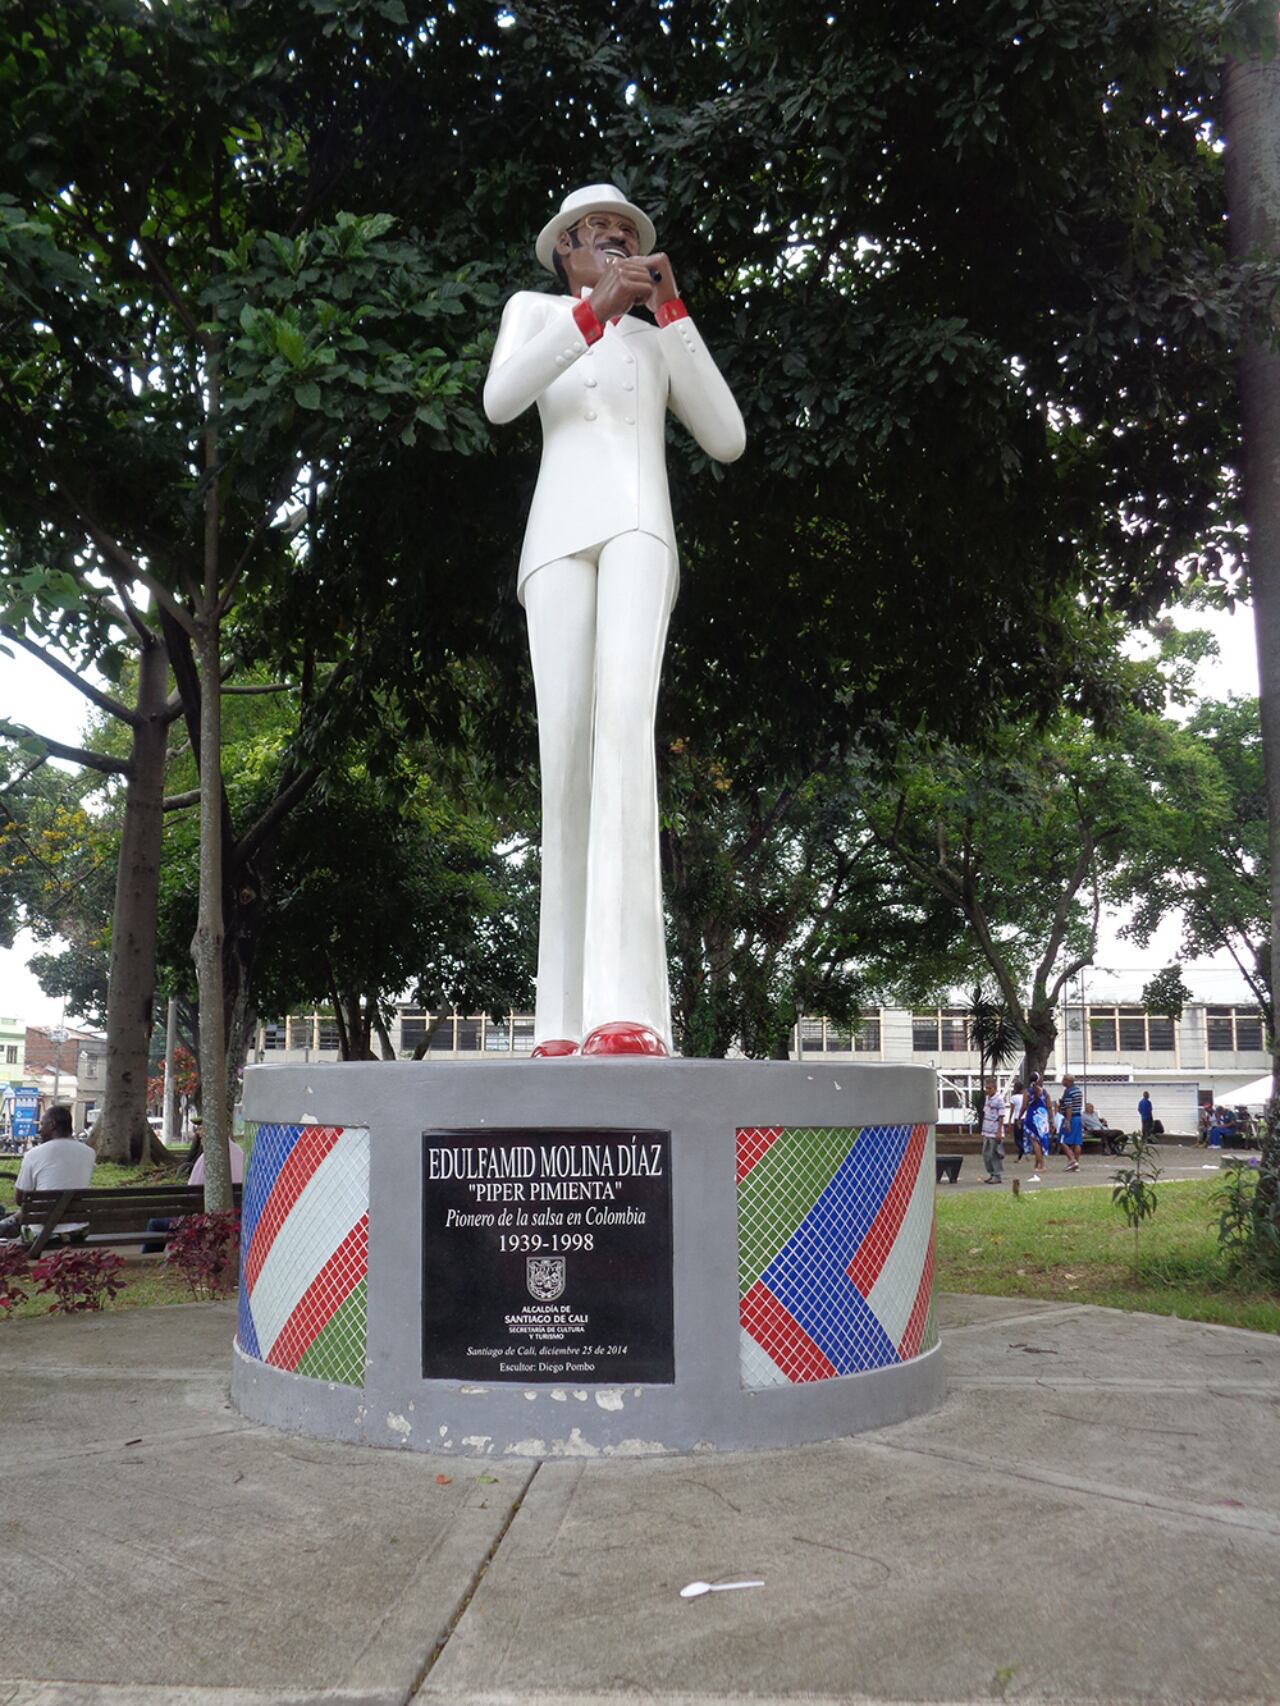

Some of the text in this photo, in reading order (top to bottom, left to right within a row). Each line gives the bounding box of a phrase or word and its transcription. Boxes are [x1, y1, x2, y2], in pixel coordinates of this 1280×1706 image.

[428, 1135, 663, 1180] EDULFAMID MOLINA DÍAZ
[469, 1181, 622, 1202] "PIPER PIMIENTA"
[445, 1206, 646, 1227] Pionero de la salsa en Colombia
[499, 1233, 594, 1252] 1939-1998
[521, 1305, 571, 1313] ALCALDÍA DE
[504, 1315, 589, 1324] SANTIAGO DE CALI
[466, 1345, 628, 1358] Santiago de Cali, diciembre 25 de 2014
[499, 1362, 596, 1374] Escultor: Diego Pombo
